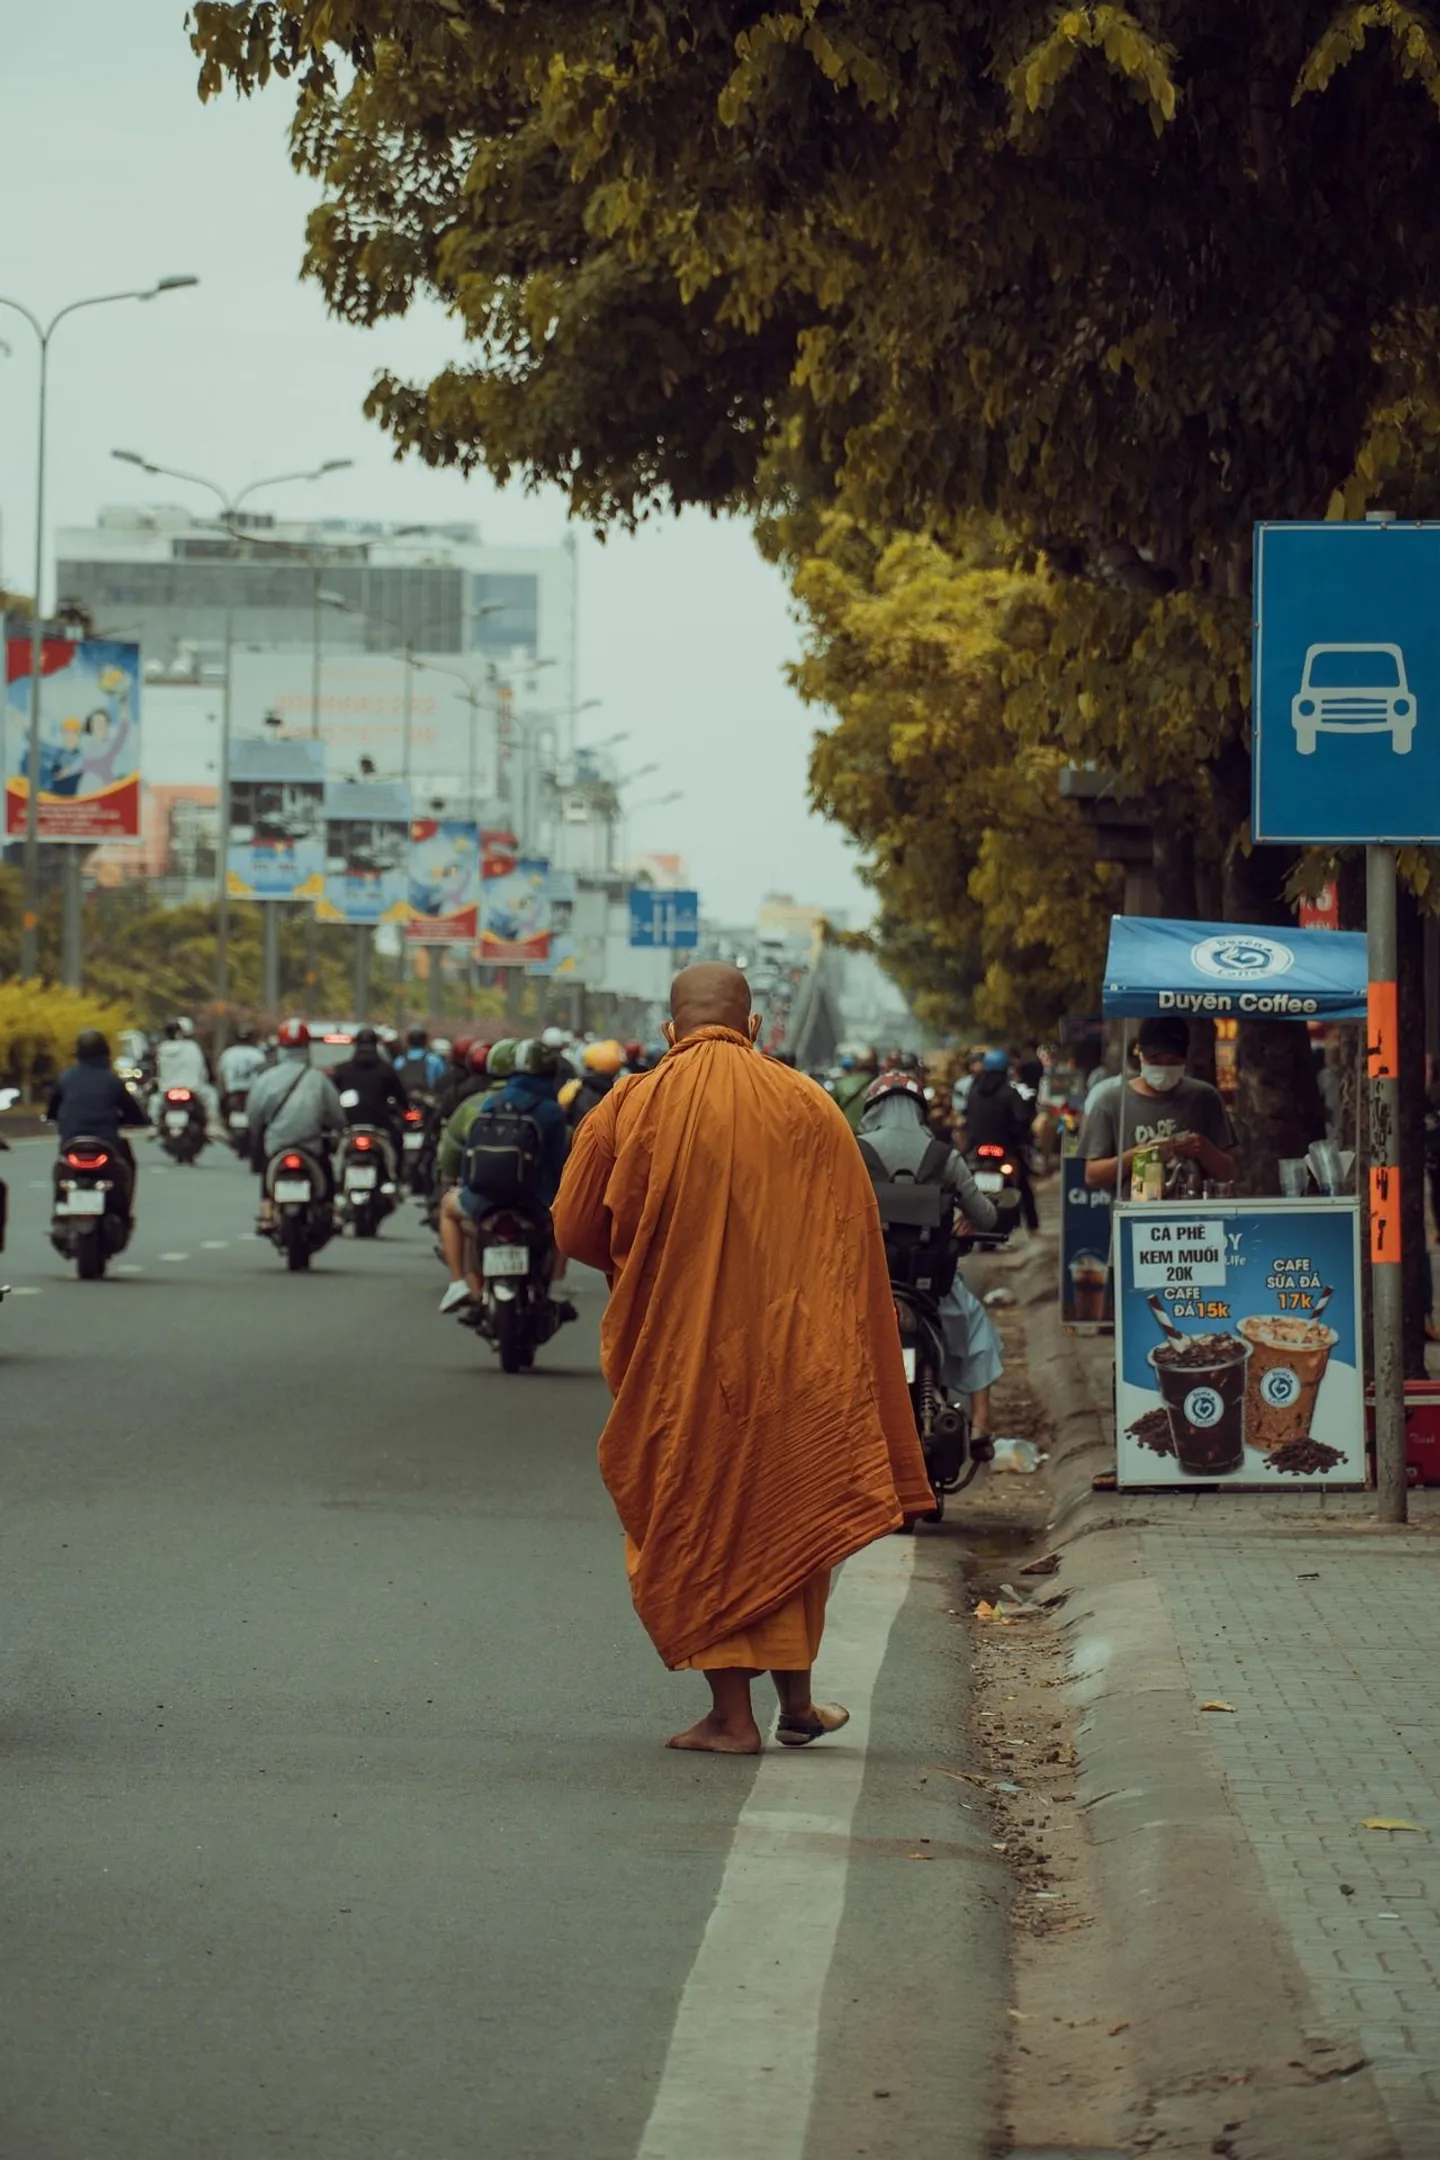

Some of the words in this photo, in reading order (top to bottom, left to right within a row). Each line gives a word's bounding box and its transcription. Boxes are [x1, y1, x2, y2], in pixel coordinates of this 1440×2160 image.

[1239, 993, 1318, 1013] Coffee
[1151, 1224, 1171, 1241] CÀ
[1176, 1224, 1206, 1240] PHÊ
[1139, 1250, 1173, 1264] KEM
[1273, 1259, 1310, 1271] CAFE
[1167, 1266, 1193, 1281] 20K
[1299, 1272, 1321, 1288] ĐÁ
[1164, 1287, 1201, 1300] CAFE
[1278, 1293, 1312, 1309] 17k
[1173, 1301, 1195, 1317] ĐÁ
[1196, 1302, 1229, 1318] 15k
